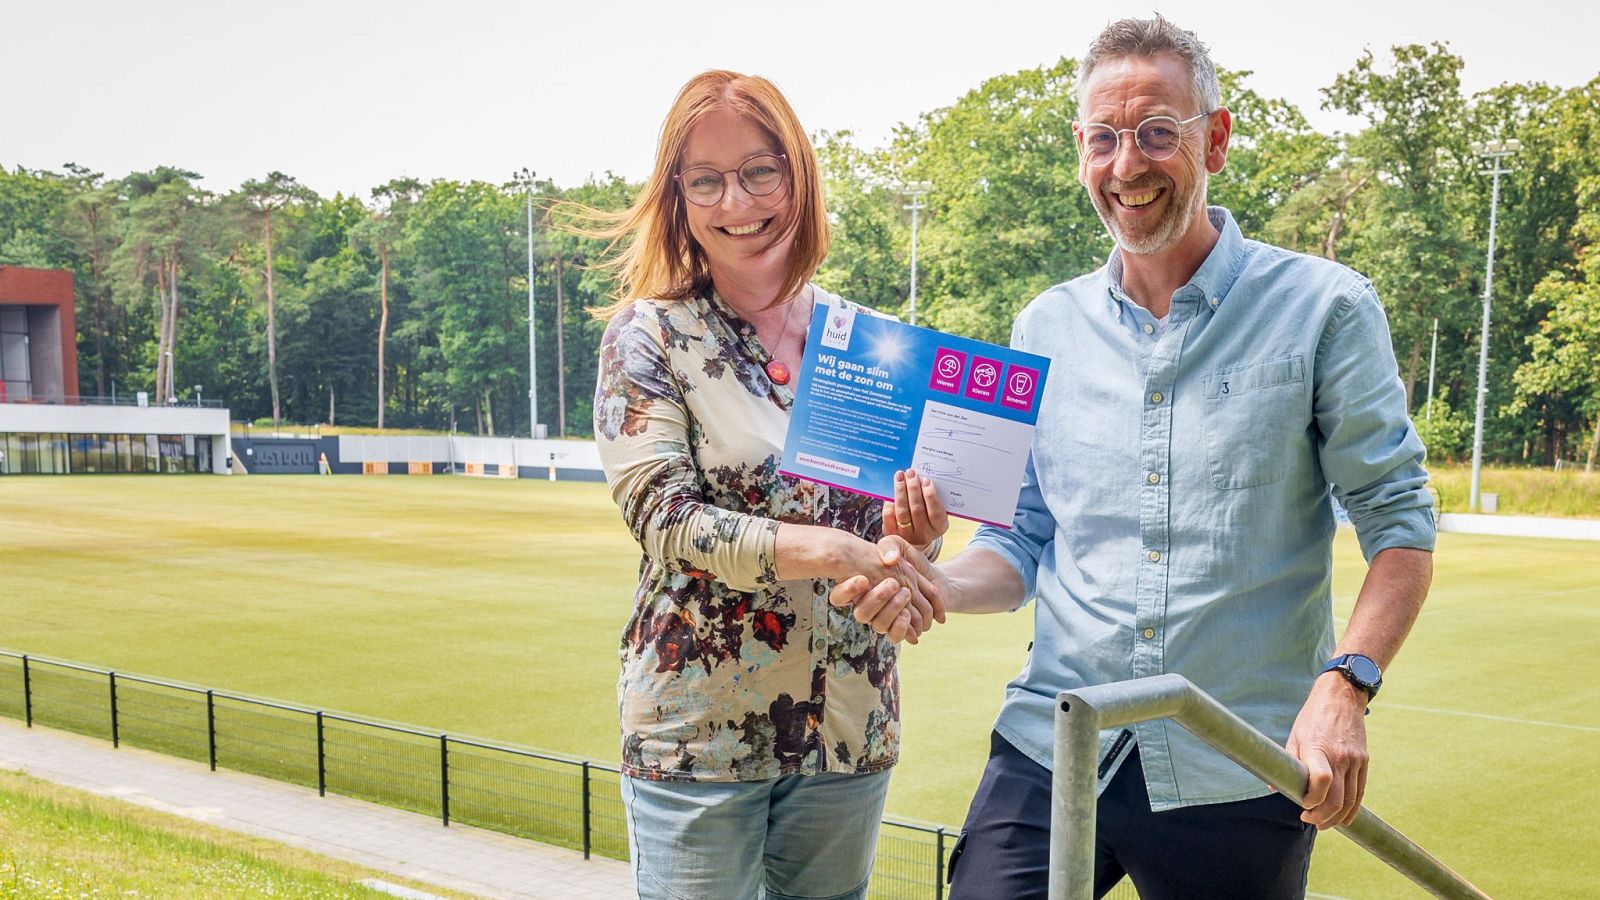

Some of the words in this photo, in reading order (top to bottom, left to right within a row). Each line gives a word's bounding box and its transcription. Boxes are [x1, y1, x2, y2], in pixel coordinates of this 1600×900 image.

[826, 328, 846, 340] huid
[818, 353, 836, 367] Wij
[838, 360, 864, 374] gaan
[866, 366, 889, 378] slim
[815, 366, 836, 377] met
[838, 370, 852, 381] de
[854, 376, 873, 386] zon
[876, 381, 893, 391] om
[1006, 395, 1028, 405] Smeren
